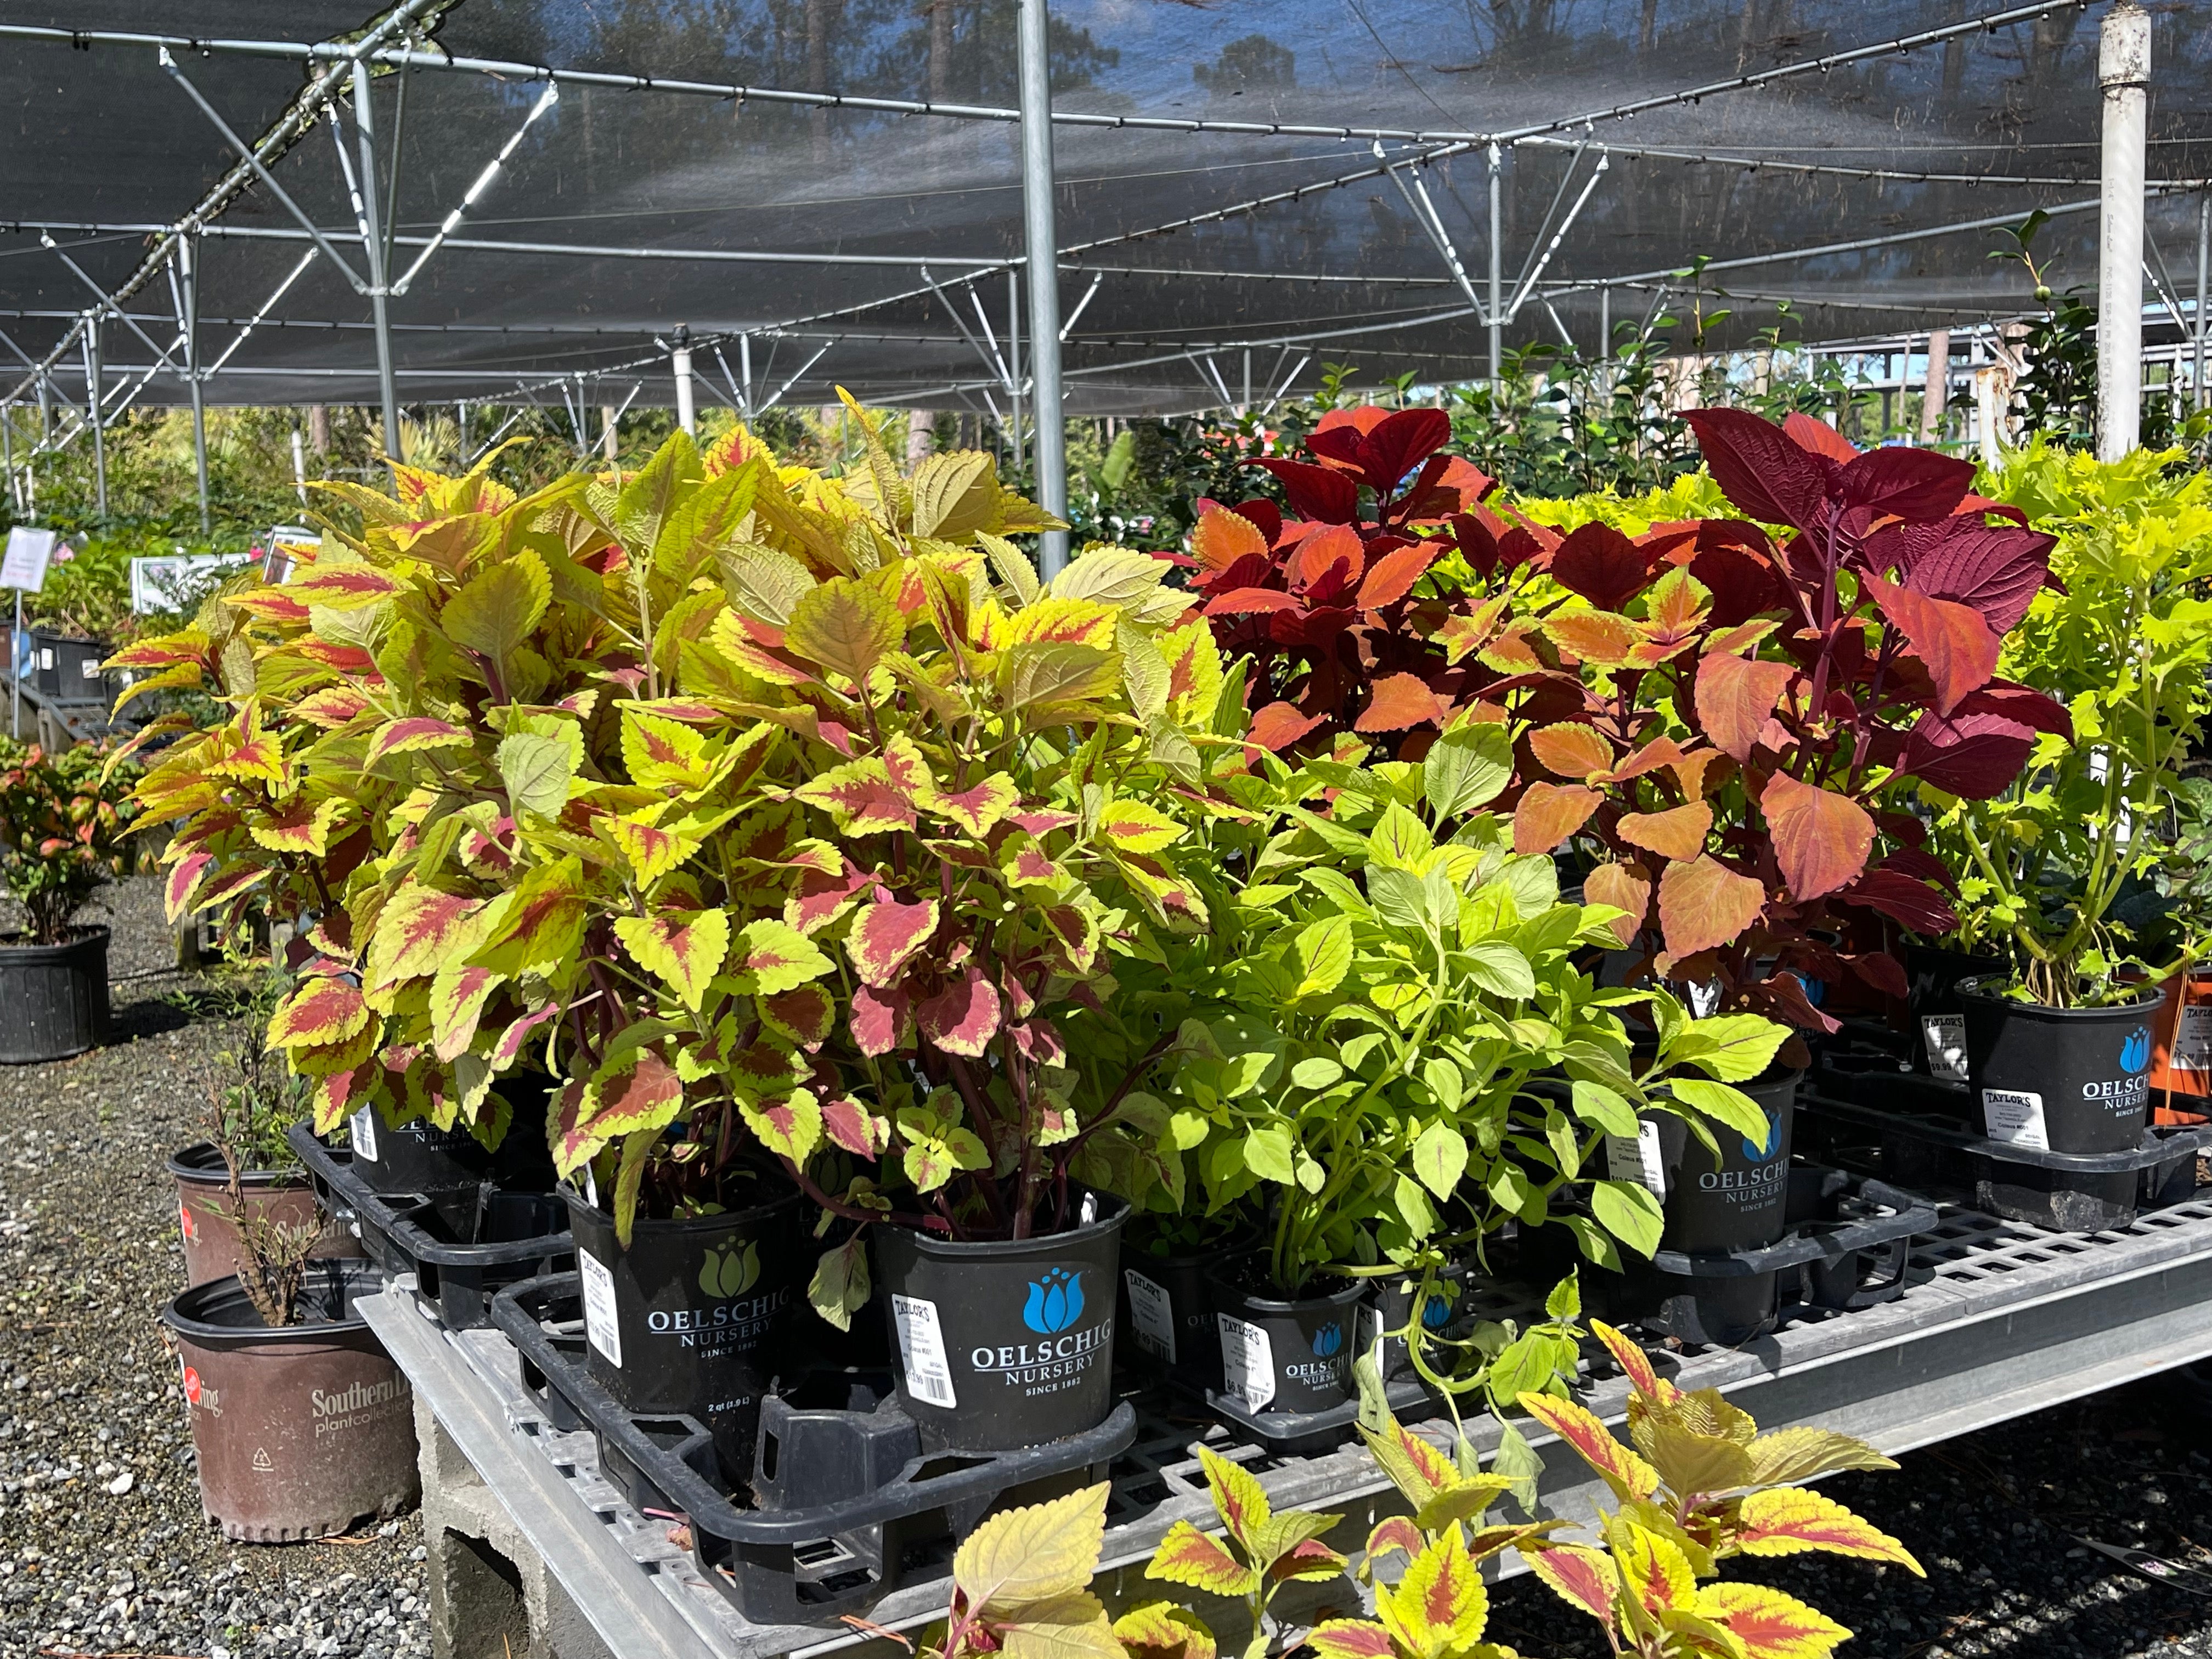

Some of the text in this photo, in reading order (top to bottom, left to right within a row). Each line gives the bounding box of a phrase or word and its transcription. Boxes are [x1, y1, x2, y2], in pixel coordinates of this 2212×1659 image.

[2104, 330, 2111, 338] PR
[1924, 1017, 1963, 1029] TAYLOR'S
[2187, 1008, 2212, 1018] TAYLO
[2083, 1073, 2149, 1098] OELSCH
[1985, 1092, 2030, 1108] TAYLOR'S
[2104, 1092, 2148, 1109] NURSER
[1699, 1158, 1788, 1189] OELSCHI
[1740, 1201, 1762, 1212] SINCE
[1128, 1272, 1161, 1302] TAYLOR'S
[648, 1285, 790, 1331] OELSCHIG
[895, 1299, 930, 1322] TAYLOR'S
[680, 1318, 771, 1347] NURSERY
[972, 1318, 1111, 1368] OELSCHIG
[1222, 1318, 1260, 1346] TAYLOR'S
[701, 1346, 733, 1358] SINCE
[1285, 1351, 1351, 1376] OELSCHI
[1006, 1352, 1095, 1385] NURSERY
[1025, 1376, 1081, 1396] SINCE 1882
[312, 1380, 394, 1418] Southern
[708, 1404, 714, 1412] 2
[715, 1402, 725, 1412] qt
